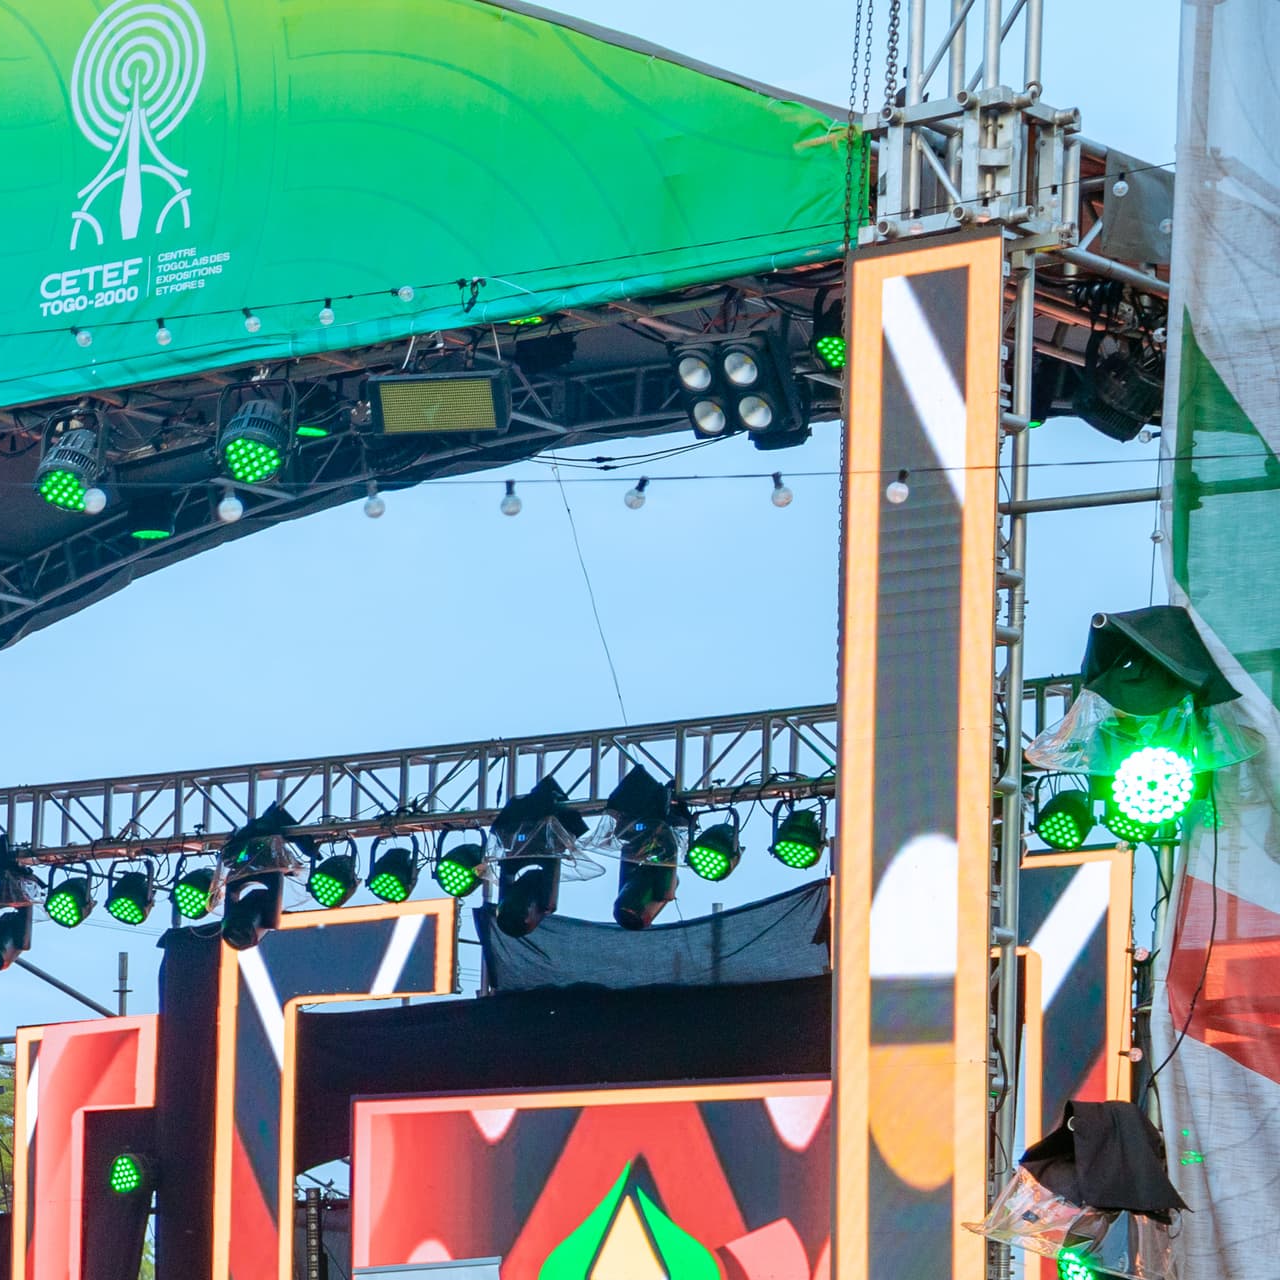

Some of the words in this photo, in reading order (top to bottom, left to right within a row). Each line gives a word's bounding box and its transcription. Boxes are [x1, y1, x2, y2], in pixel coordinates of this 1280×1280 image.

[157, 256, 209, 273] TOGOLAIS
[209, 252, 230, 264] DES
[158, 247, 196, 262] CENTRE
[40, 257, 143, 300] CETEF
[155, 264, 222, 285] EXPOSITIONS
[155, 285, 169, 296] ET
[40, 286, 139, 317] TOGO-2000
